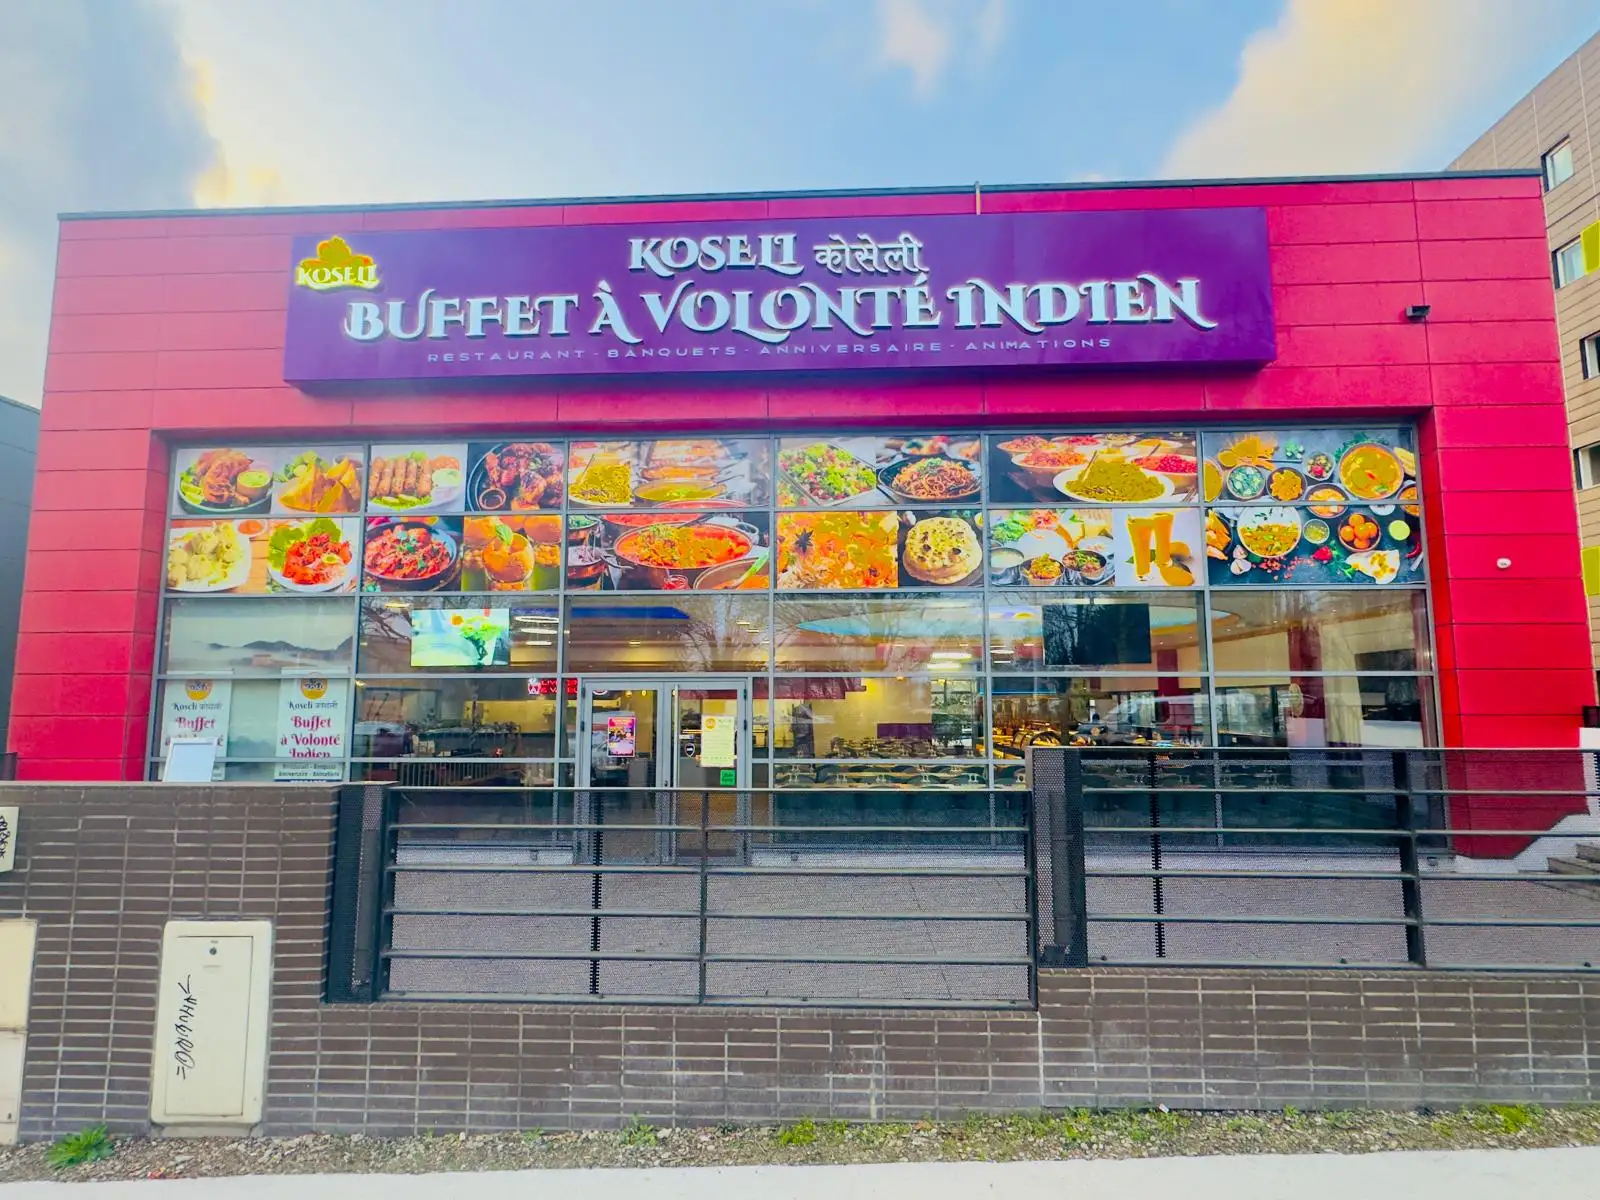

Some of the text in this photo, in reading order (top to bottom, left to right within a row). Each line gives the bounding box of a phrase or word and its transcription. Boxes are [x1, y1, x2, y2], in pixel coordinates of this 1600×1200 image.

[628, 233, 929, 276] KOSELI कोसेली
[344, 272, 1219, 344] BUFFET À VOLONTÉ INDIEN
[427, 338, 1112, 363] RESTAURANT BANQUETS ANNIVERSAIRE ANIMATIONS
[291, 715, 332, 731] Buffet
[291, 732, 341, 746] Volonté
[289, 747, 332, 758] Indien
